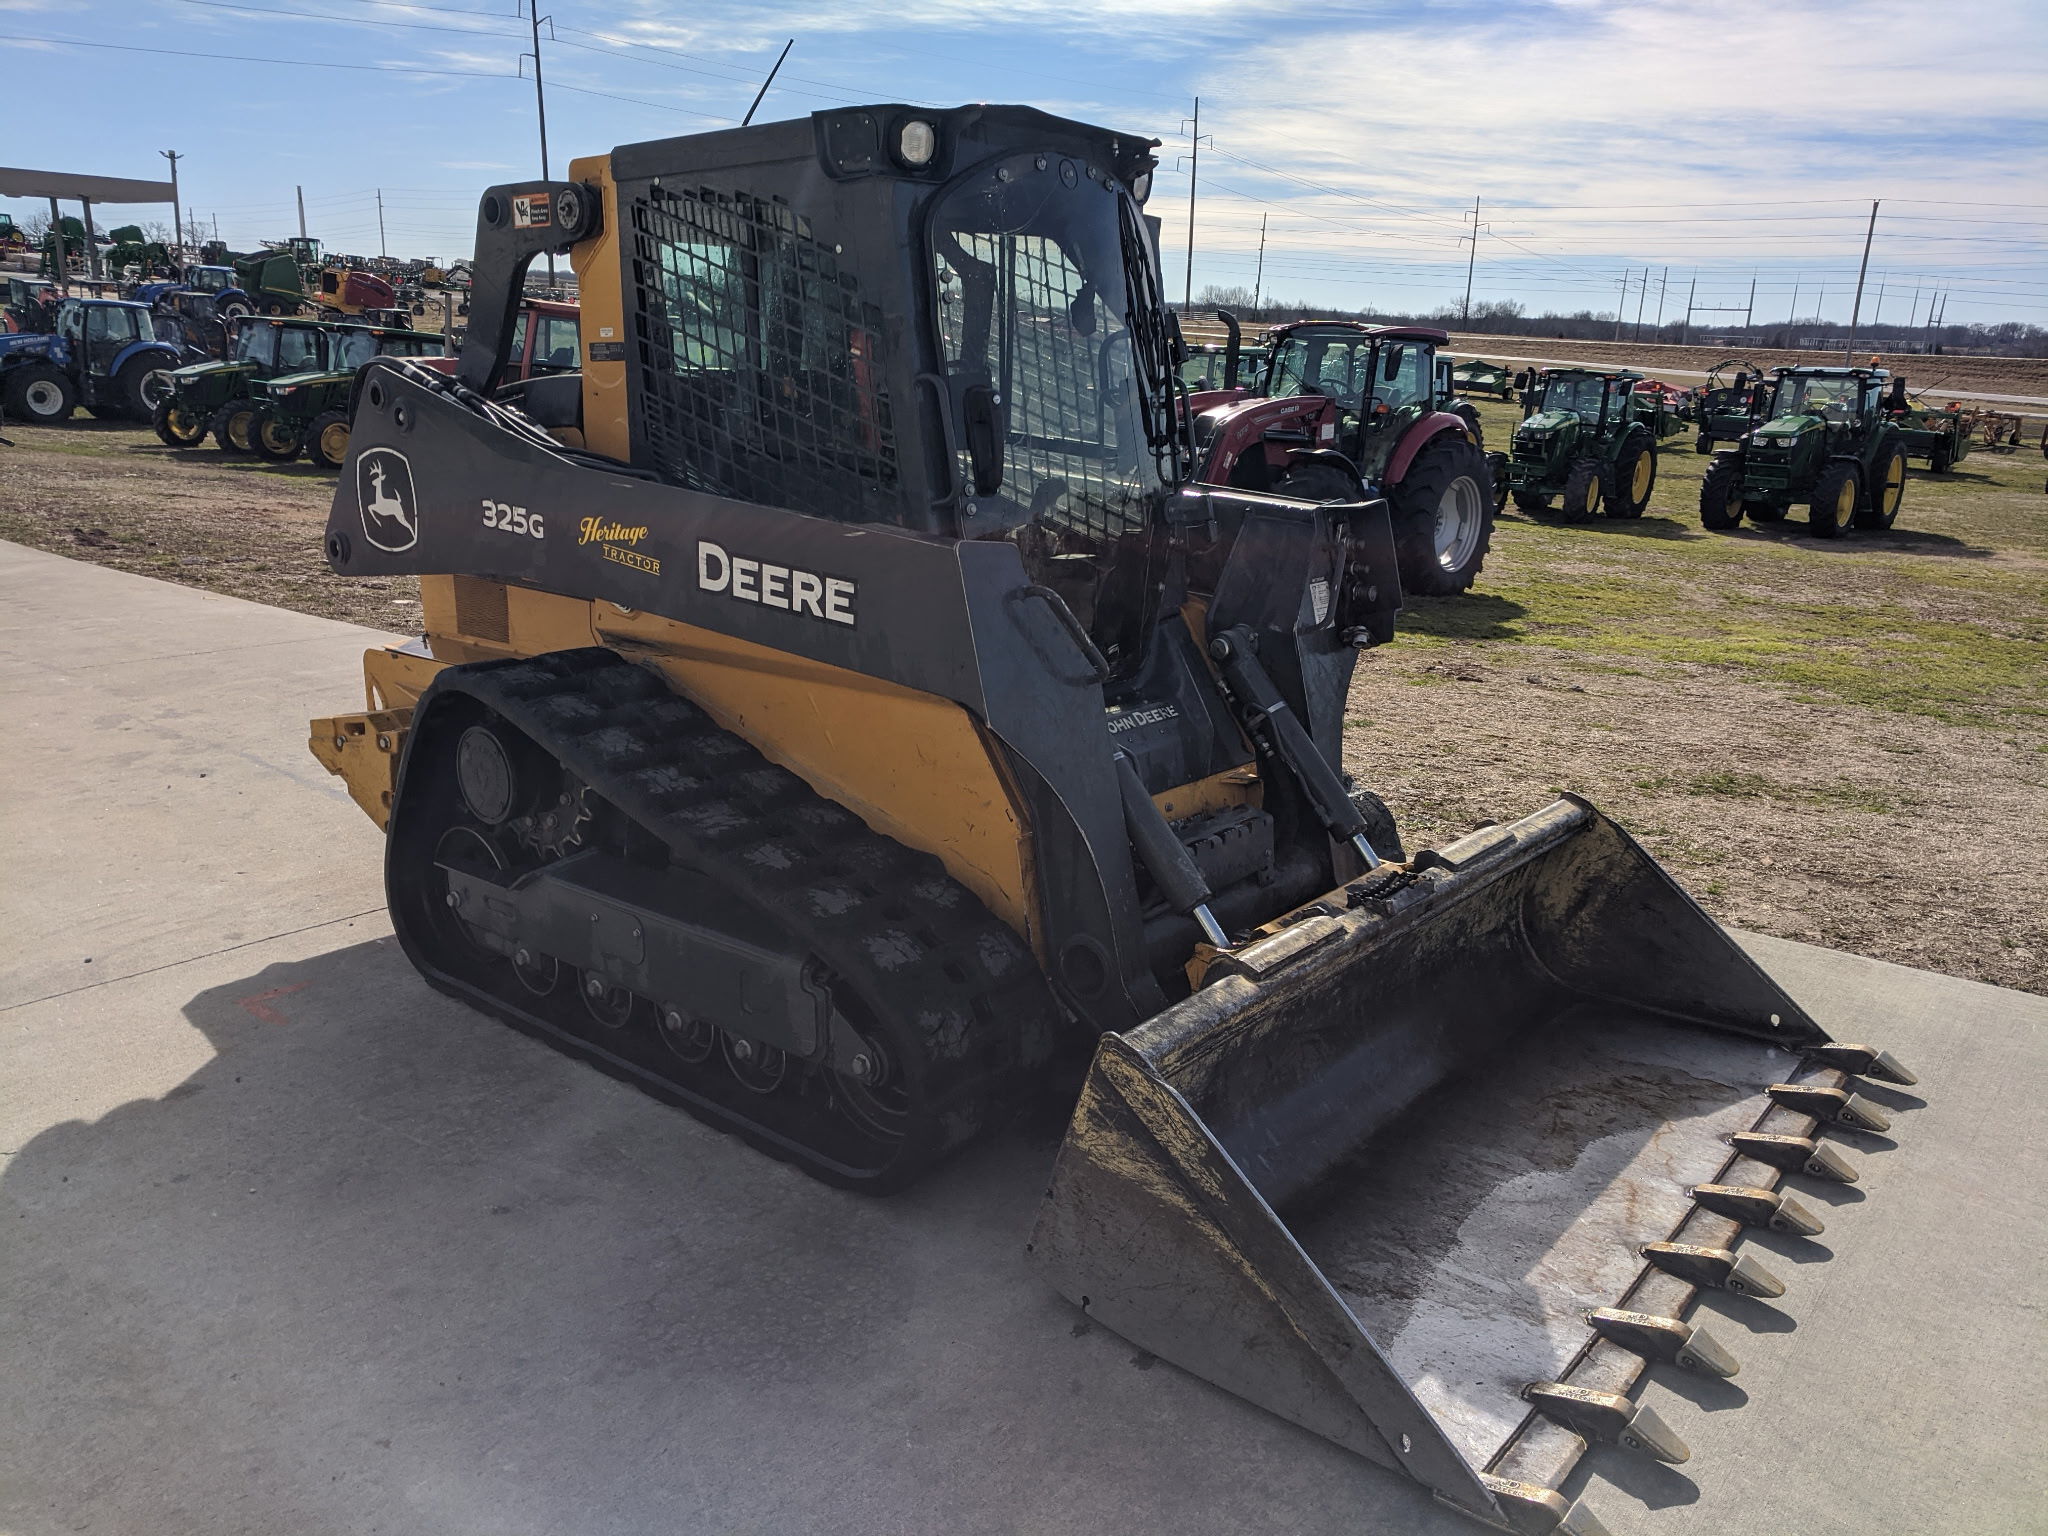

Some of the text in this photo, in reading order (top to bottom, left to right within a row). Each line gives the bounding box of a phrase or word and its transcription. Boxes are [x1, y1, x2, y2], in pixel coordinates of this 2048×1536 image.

[482, 499, 544, 539] 325G
[578, 516, 649, 546] Heritage
[603, 546, 660, 573] TRACTOR
[698, 540, 855, 625] DEERE
[1107, 705, 1180, 734] OHN DEERE
